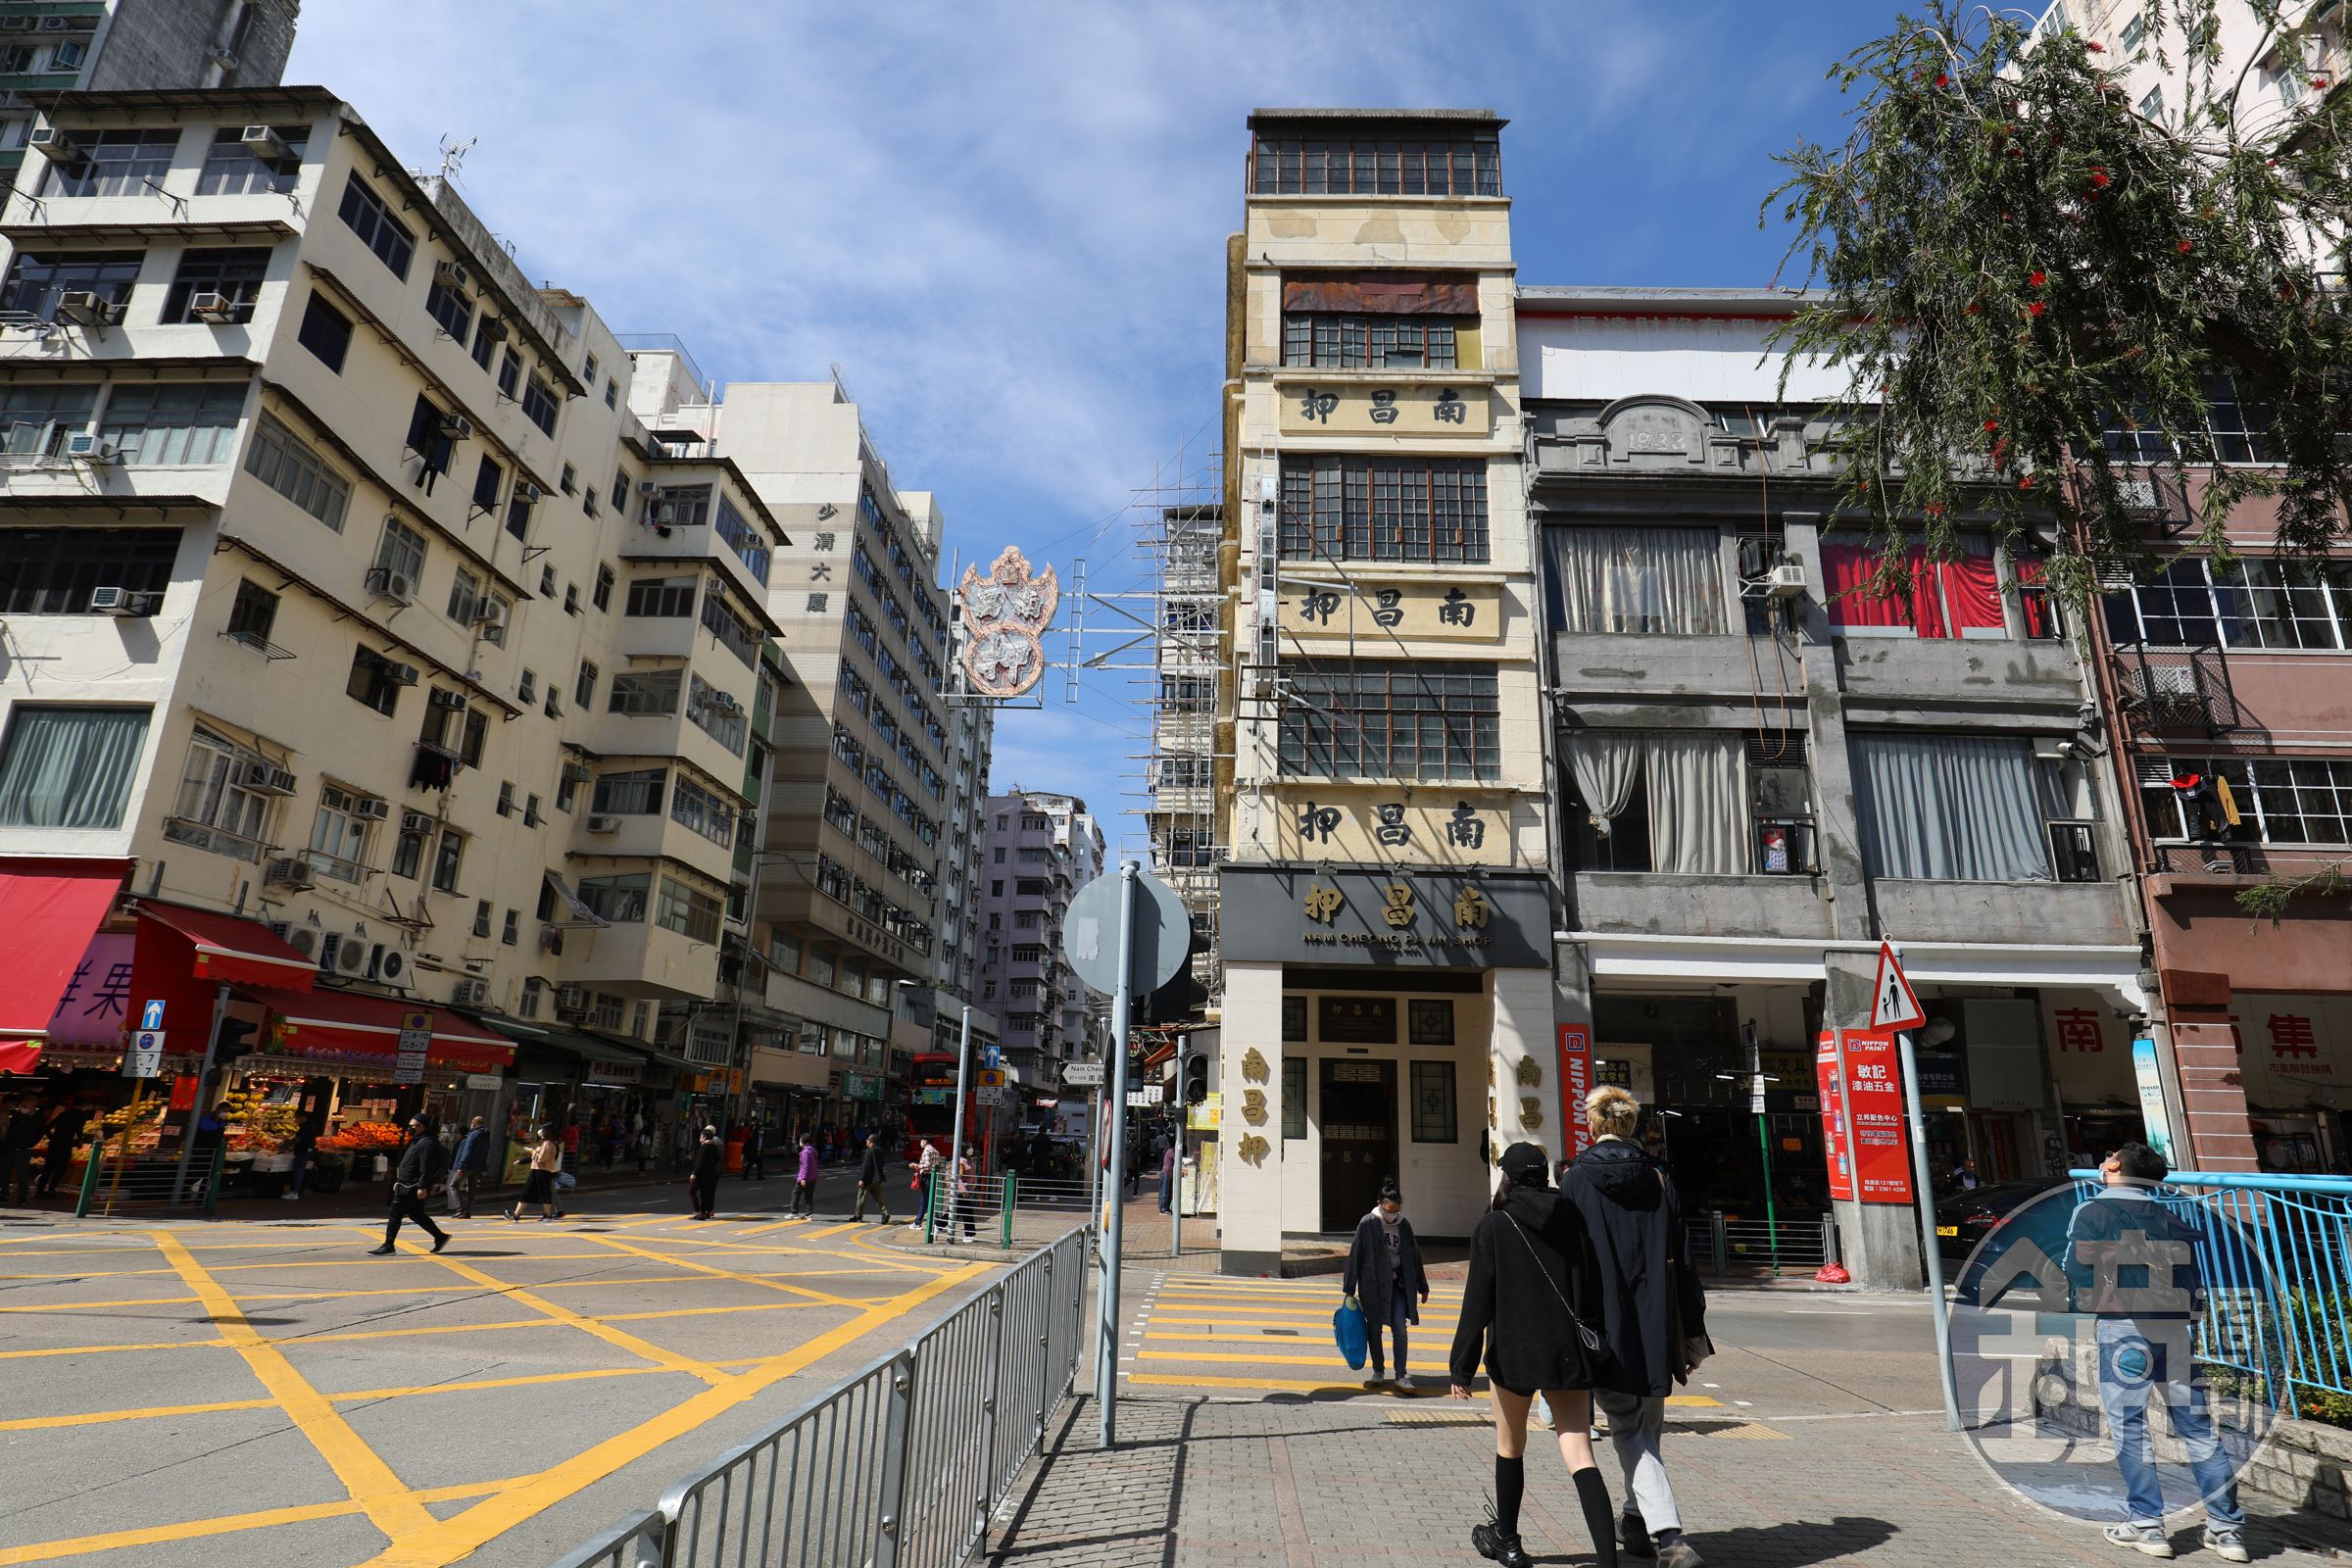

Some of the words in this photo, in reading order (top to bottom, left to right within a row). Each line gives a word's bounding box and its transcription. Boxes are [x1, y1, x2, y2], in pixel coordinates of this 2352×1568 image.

[1302, 933, 1334, 942] NAM
[1340, 933, 1398, 944] CHEONG
[1405, 934, 1447, 945] PAWN
[1454, 935, 1492, 946] SHOP
[2054, 1007, 2103, 1053] 南
[2230, 1013, 2318, 1059] 集
[148, 1054, 155, 1062] 7
[145, 1067, 152, 1076] 7
[1857, 1063, 1886, 1079] 敏記
[1570, 1057, 1587, 1125] NIPPON
[1852, 1080, 1895, 1093] 漆油五金
[1239, 1047, 1266, 1168] 南昌押
[1516, 1054, 1547, 1156] 南昌
[1384, 1232, 1400, 1249] AP
